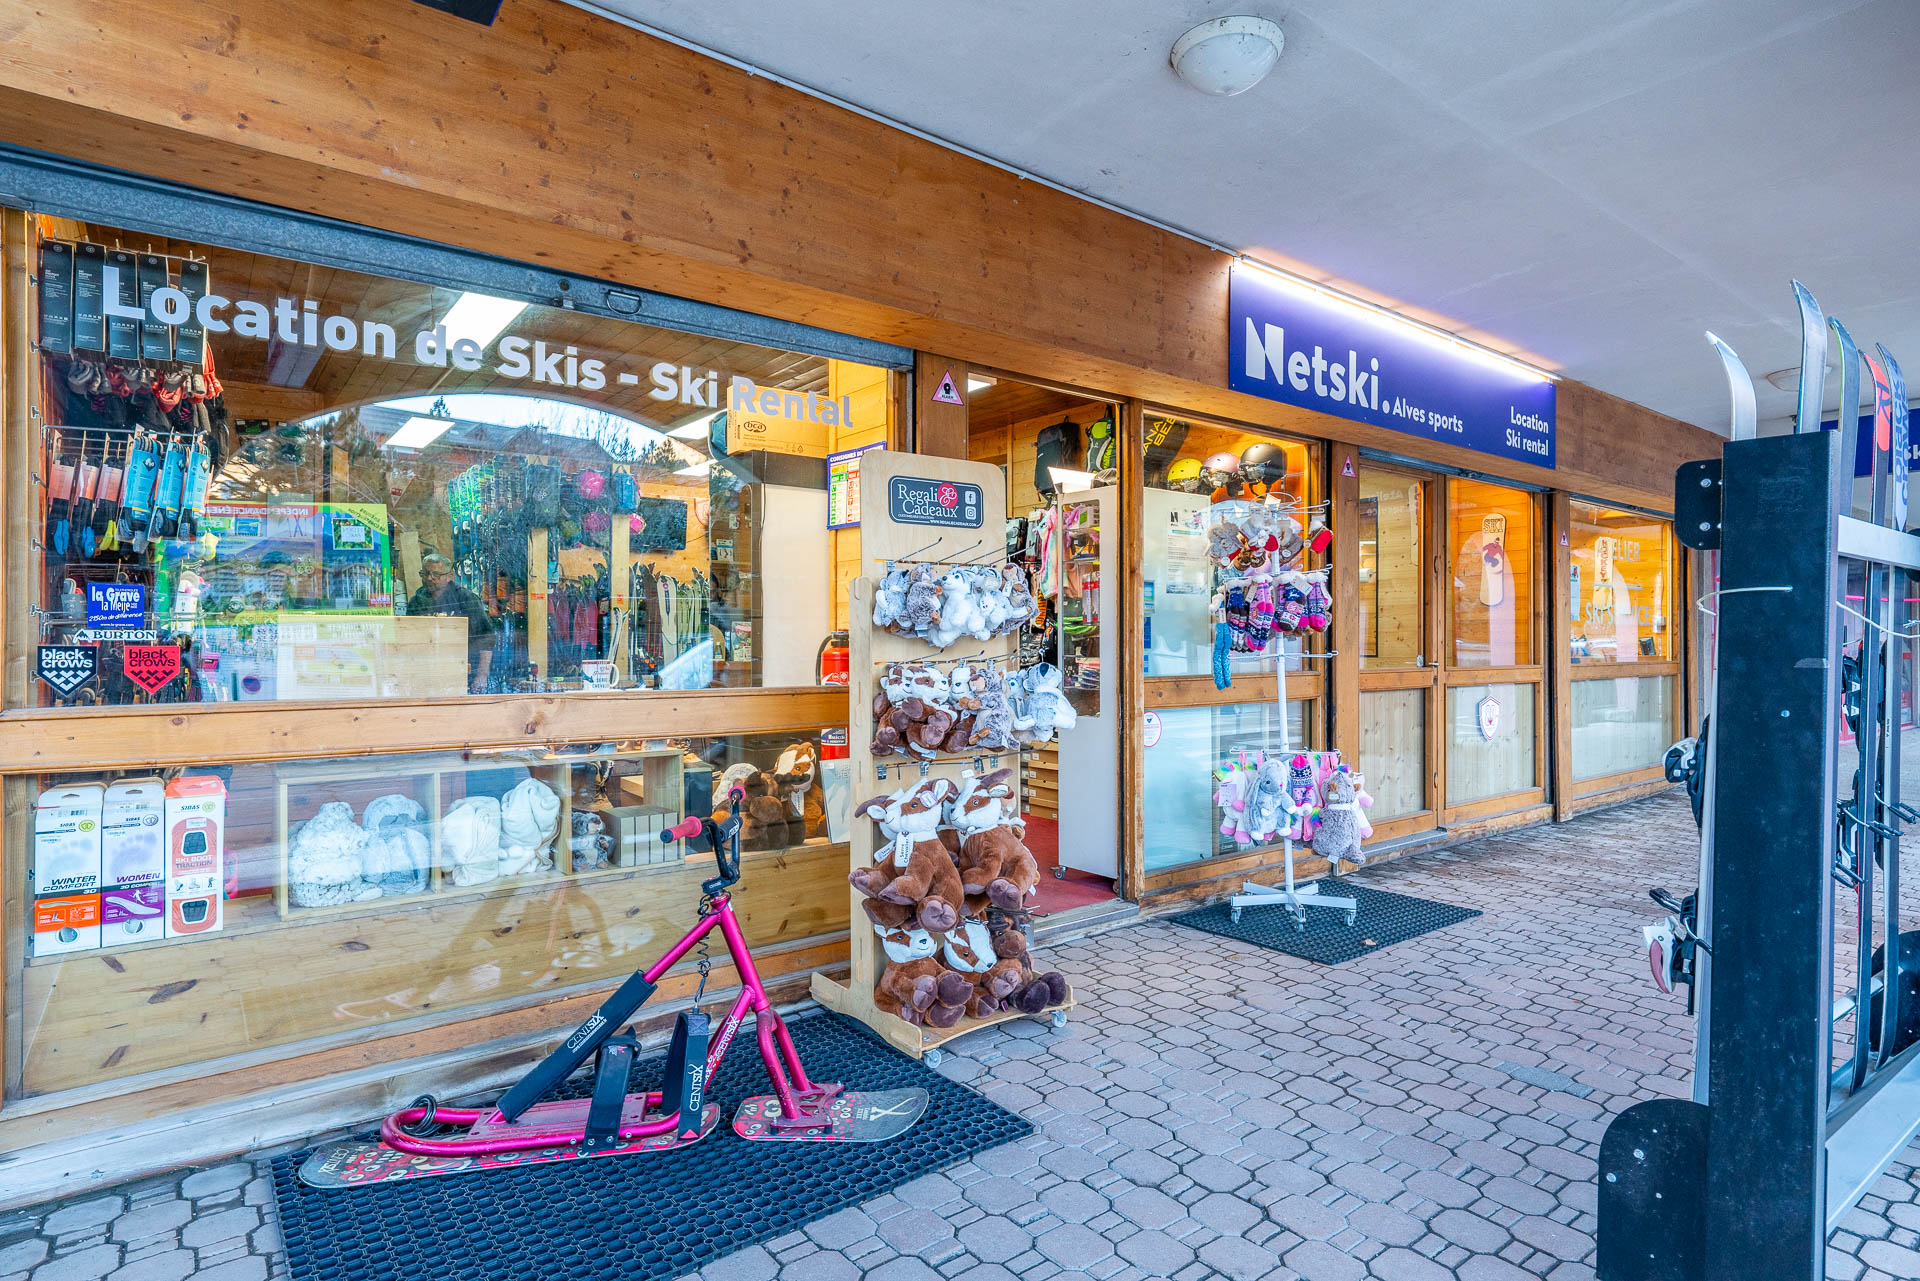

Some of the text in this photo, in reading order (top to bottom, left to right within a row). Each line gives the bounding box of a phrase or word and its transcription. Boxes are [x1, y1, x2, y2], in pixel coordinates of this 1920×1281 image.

[103, 265, 396, 360] Location
[415, 323, 484, 372] de
[497, 335, 607, 391] Skis
[649, 362, 719, 409] Ski
[731, 376, 854, 429] Rental
[1392, 396, 1464, 434] Alves sports
[1510, 405, 1549, 434] Location
[1505, 428, 1549, 457] Ski rental
[897, 483, 939, 505] Regali
[902, 499, 960, 518] Cadeaux
[1483, 517, 1504, 534] SKI
[91, 585, 140, 602] la Grave
[101, 599, 131, 613] la Meije
[1585, 602, 1604, 625] SKI
[93, 630, 155, 640] BURTON
[41, 648, 85, 660] black
[129, 648, 168, 659] black
[41, 659, 93, 668] crows
[129, 658, 176, 667] crows
[175, 860, 213, 869] TRACTION
[51, 875, 97, 886] WINTER
[116, 872, 161, 884] WOMEN
[42, 881, 97, 892] COMFORT
[688, 1063, 704, 1112] CENTSIX
